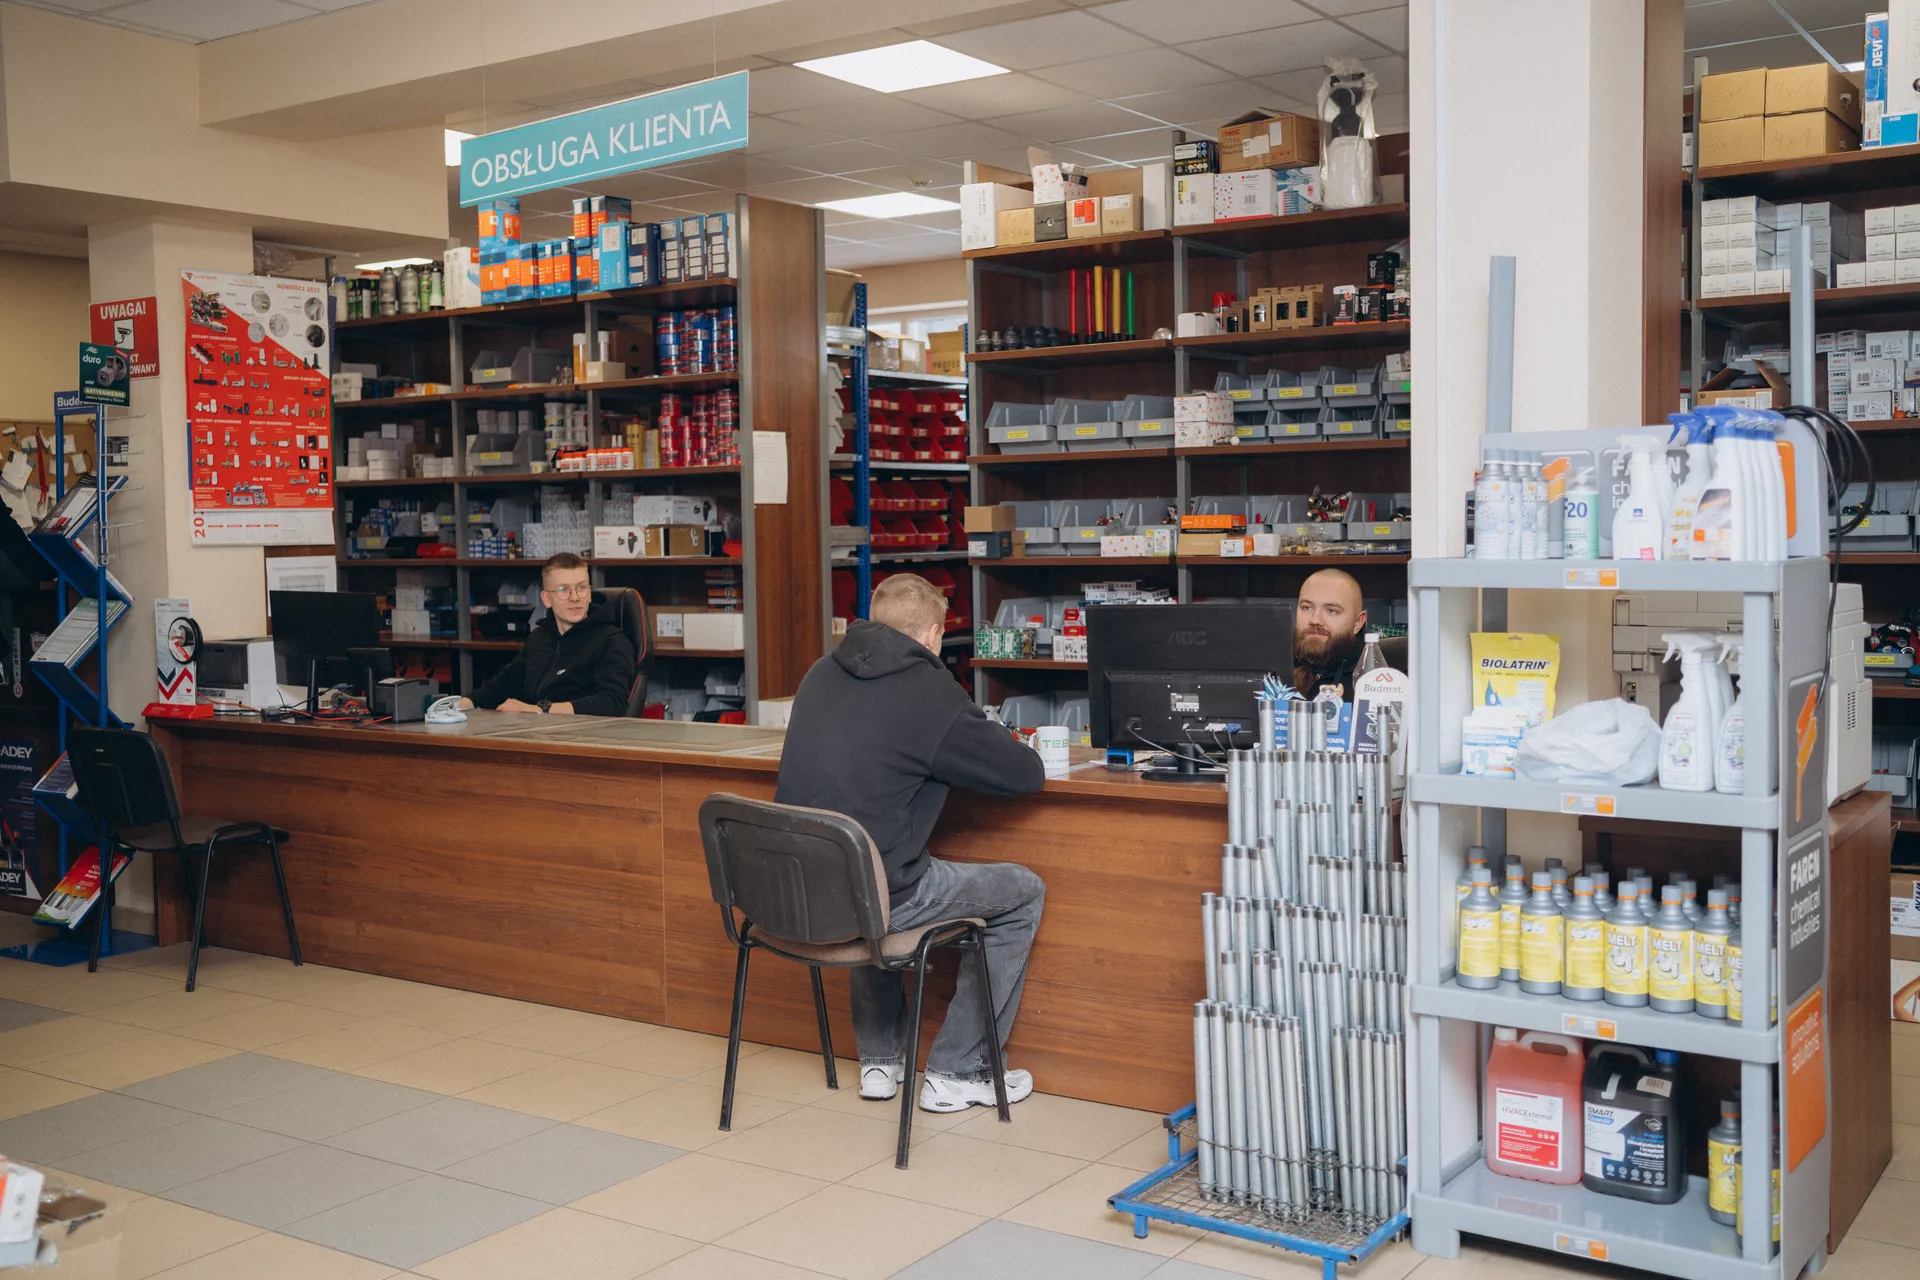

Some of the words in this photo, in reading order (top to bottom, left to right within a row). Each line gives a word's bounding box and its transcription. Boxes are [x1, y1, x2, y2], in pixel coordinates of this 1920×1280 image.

[1872, 40, 1883, 67] DEVI
[471, 132, 600, 188] OBSŁUGA
[608, 100, 732, 157] KLIENTA
[100, 301, 146, 320] UWAGA!
[130, 364, 156, 374] OWANY
[86, 388, 125, 398] ANTYKAMIENNE
[1168, 630, 1206, 645] AOC
[0, 745, 33, 759] ADEY
[1791, 848, 1820, 894] FAREN
[1608, 933, 1637, 946] MELT
[1653, 939, 1683, 952] MELT
[1697, 942, 1726, 956] MELT
[1728, 956, 1742, 969] ME
[1588, 1107, 1614, 1117] SMART
